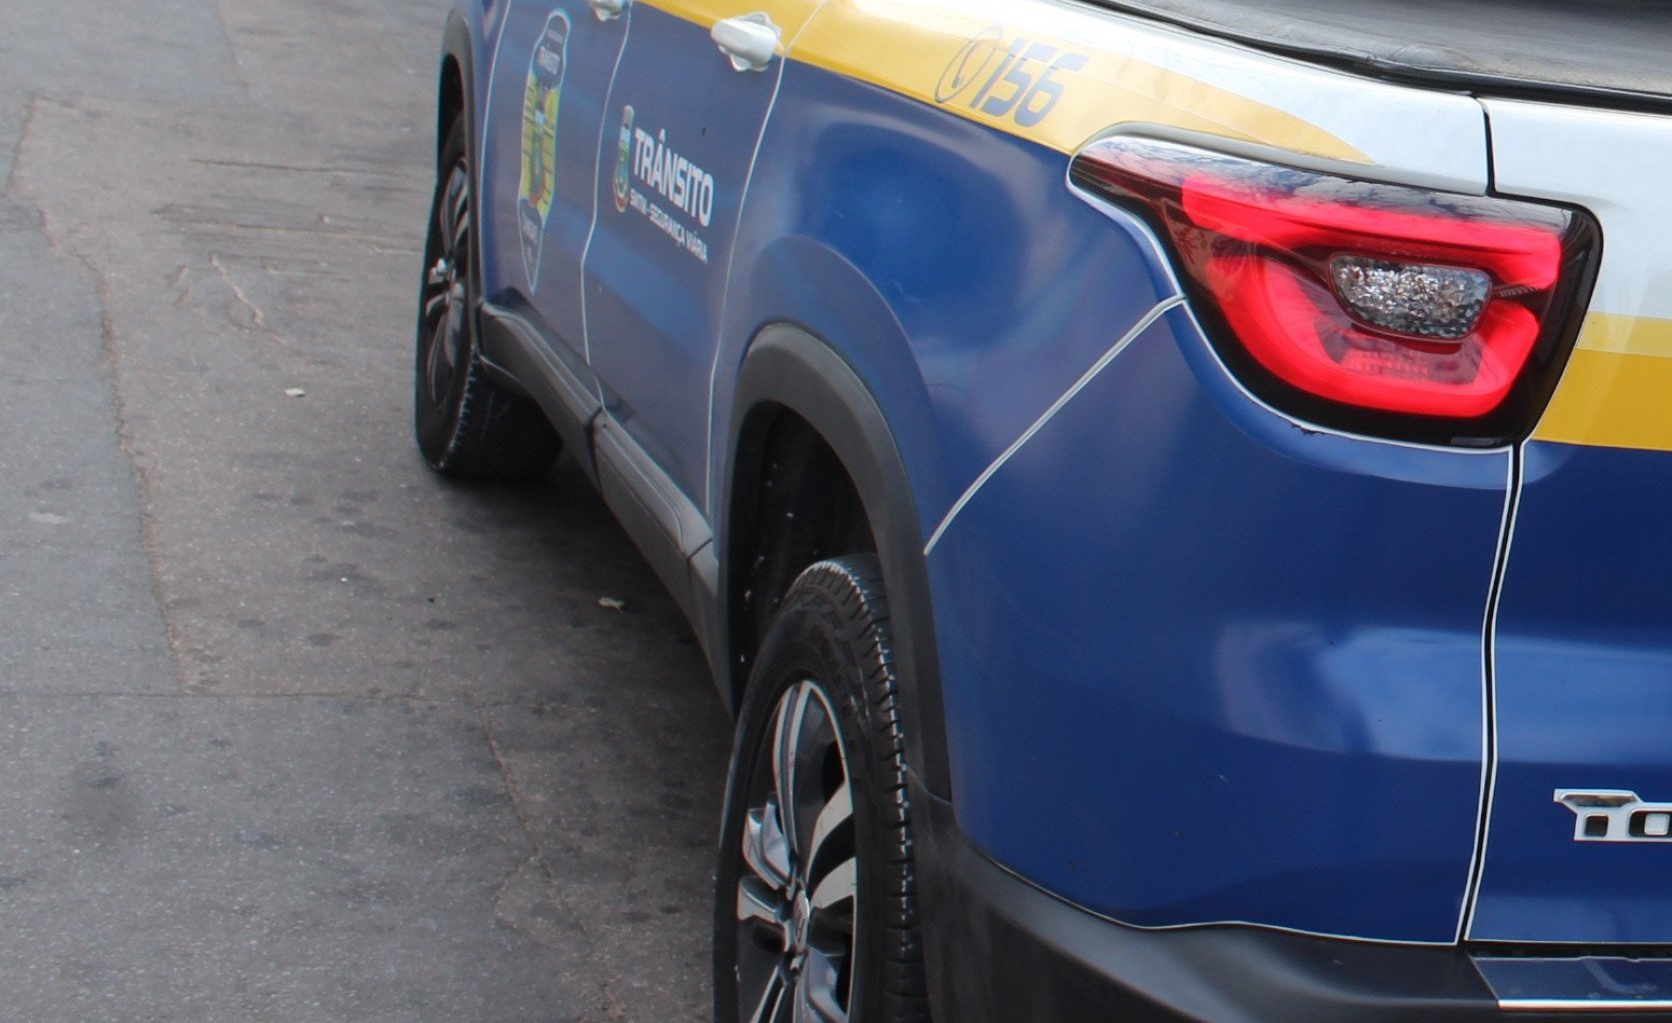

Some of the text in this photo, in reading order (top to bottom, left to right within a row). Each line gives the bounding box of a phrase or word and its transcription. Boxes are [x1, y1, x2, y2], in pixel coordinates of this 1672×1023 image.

[968, 37, 1090, 128] 156
[634, 128, 714, 227] TRÂNSITO
[649, 203, 686, 247] SEGURANÇA
[685, 229, 708, 264] VIÁRIA
